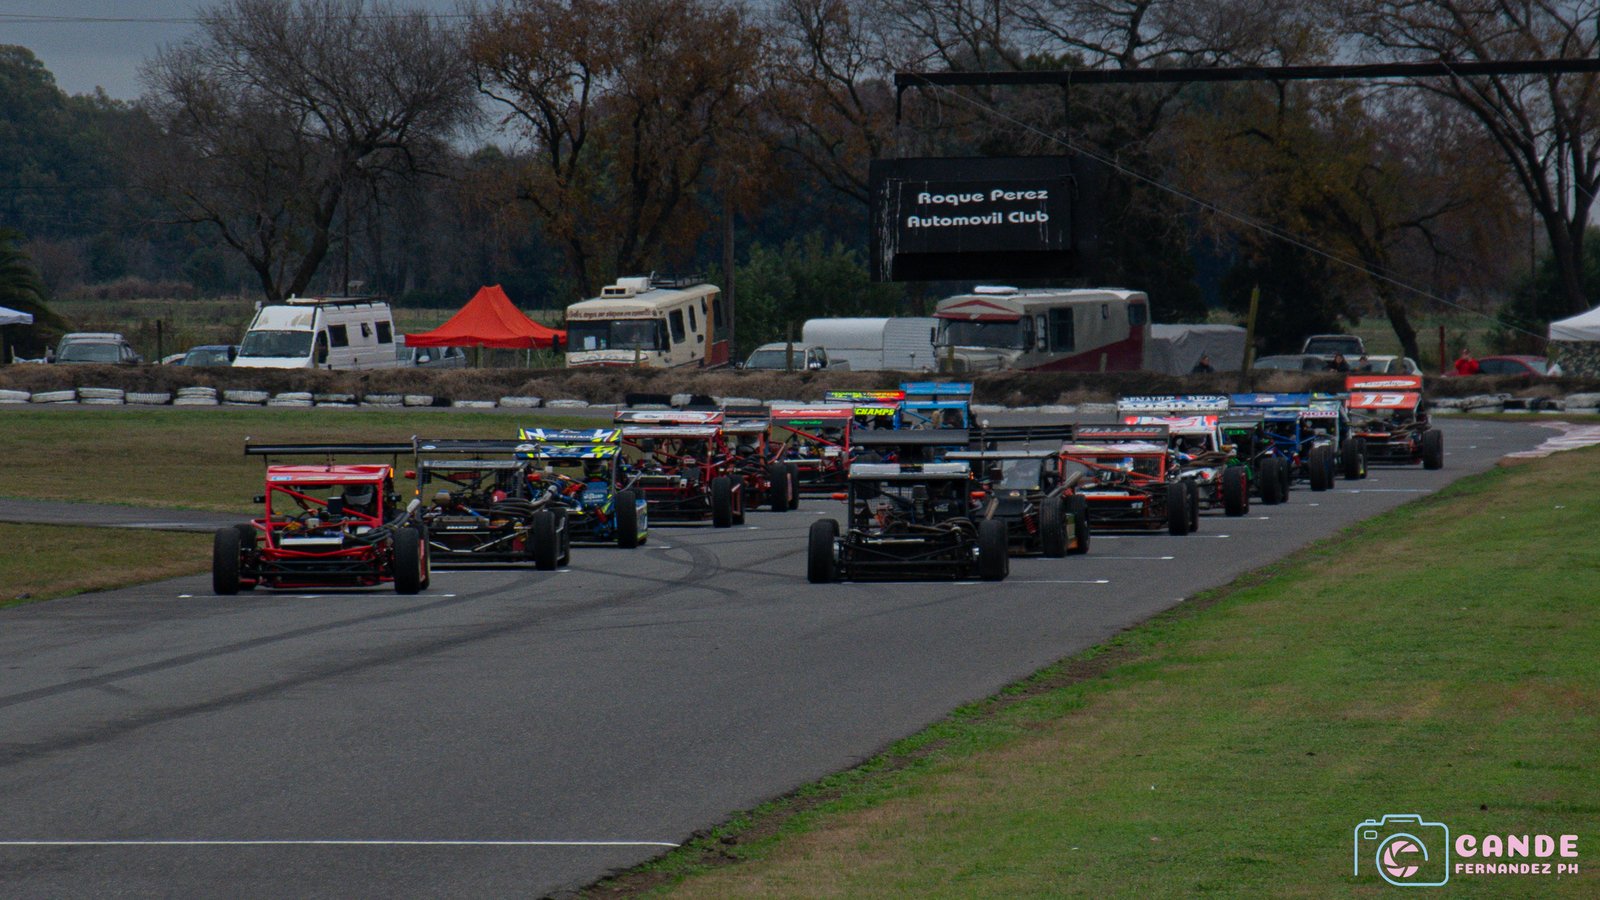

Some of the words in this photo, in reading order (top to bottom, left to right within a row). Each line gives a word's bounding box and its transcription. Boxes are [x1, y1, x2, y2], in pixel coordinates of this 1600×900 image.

[918, 192, 985, 206] Roque
[990, 189, 1049, 201] Perez
[907, 212, 1003, 228] Automovil
[1008, 210, 1049, 223] Club
[1361, 394, 1405, 406] 13
